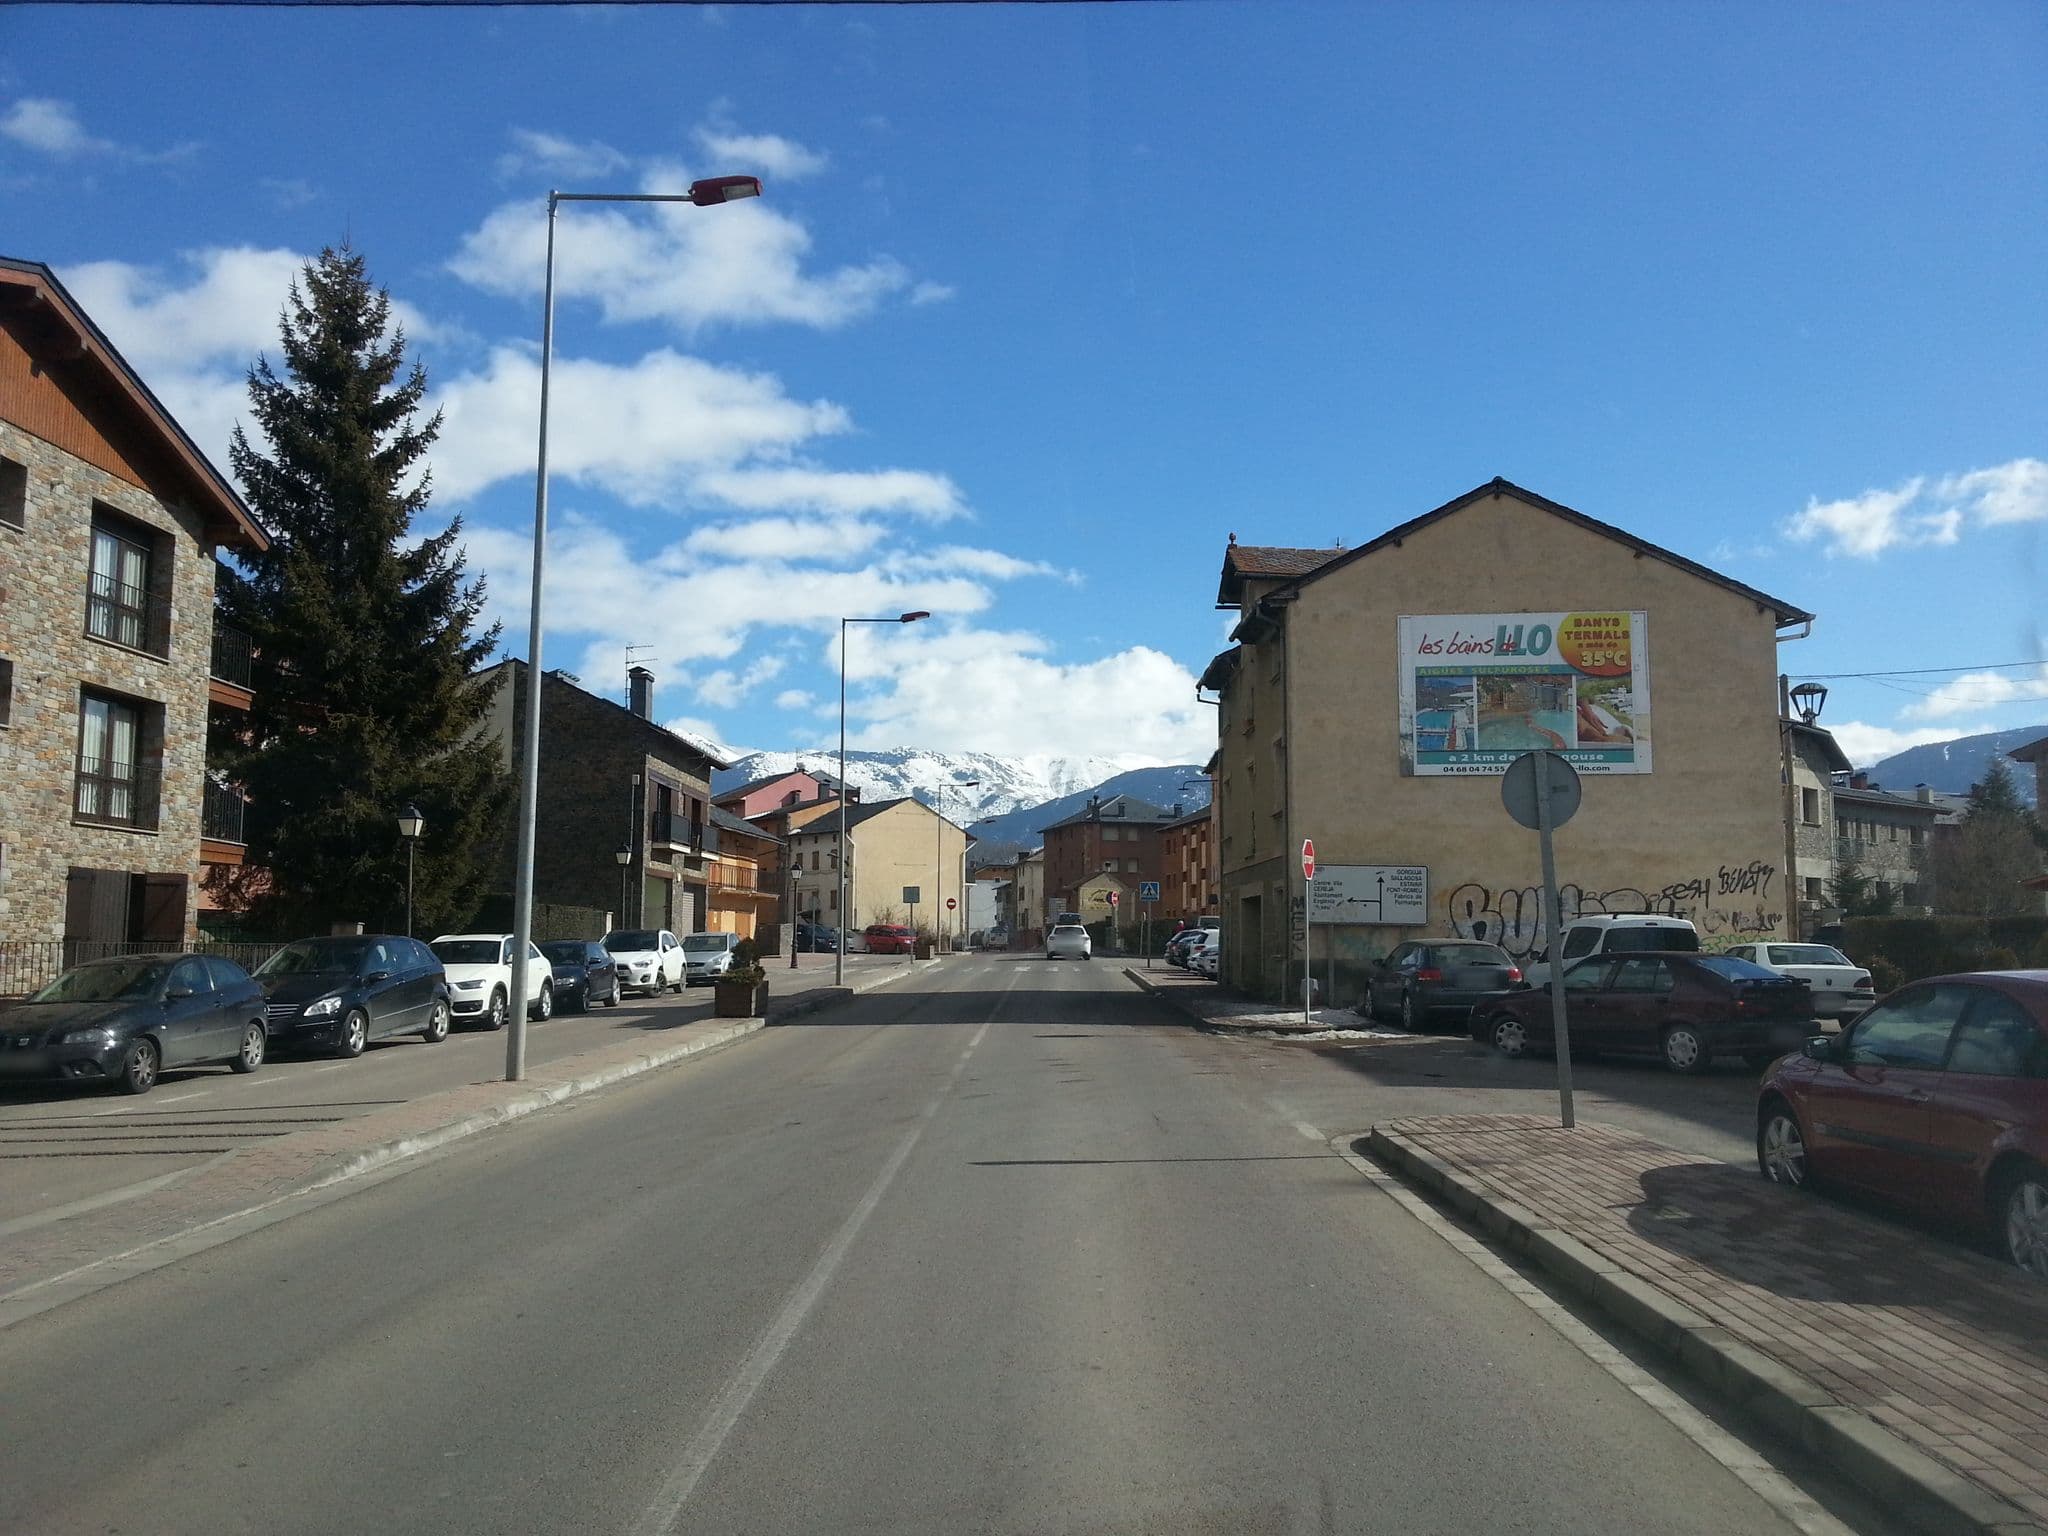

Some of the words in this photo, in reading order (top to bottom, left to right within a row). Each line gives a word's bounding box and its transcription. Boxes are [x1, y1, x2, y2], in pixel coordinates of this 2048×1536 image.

[1574, 617, 1620, 627] BANYS
[1418, 633, 1444, 654] les
[1446, 631, 1495, 655] bains
[1494, 624, 1553, 656] LLO
[1565, 630, 1630, 640] TERMALS
[1462, 754, 1469, 762] 2
[1474, 753, 1494, 762] km
[1498, 753, 1516, 761] de
